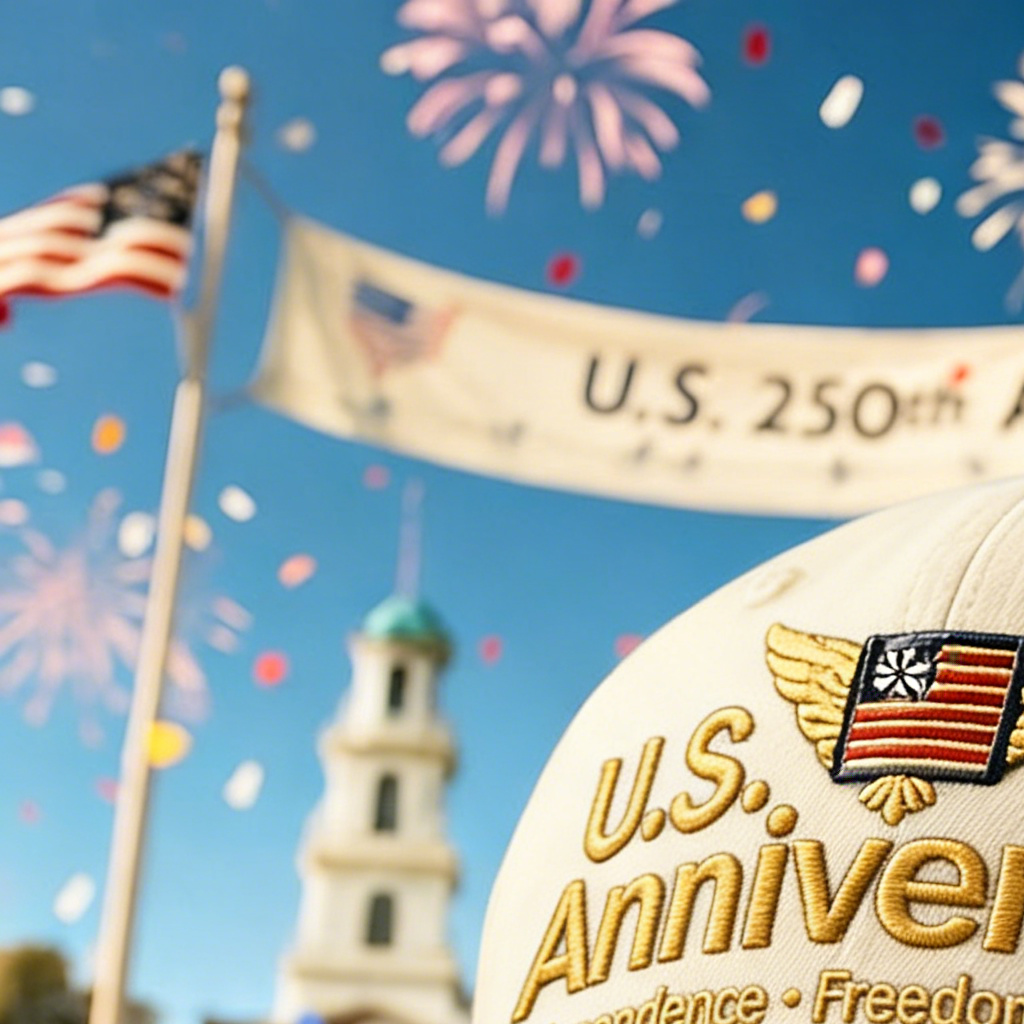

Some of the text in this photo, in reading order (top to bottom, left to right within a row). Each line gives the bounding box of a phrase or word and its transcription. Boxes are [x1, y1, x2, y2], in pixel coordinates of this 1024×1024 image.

[580, 353, 724, 428] U.S.
[754, 371, 967, 440] 250th
[584, 705, 769, 863] U.S.
